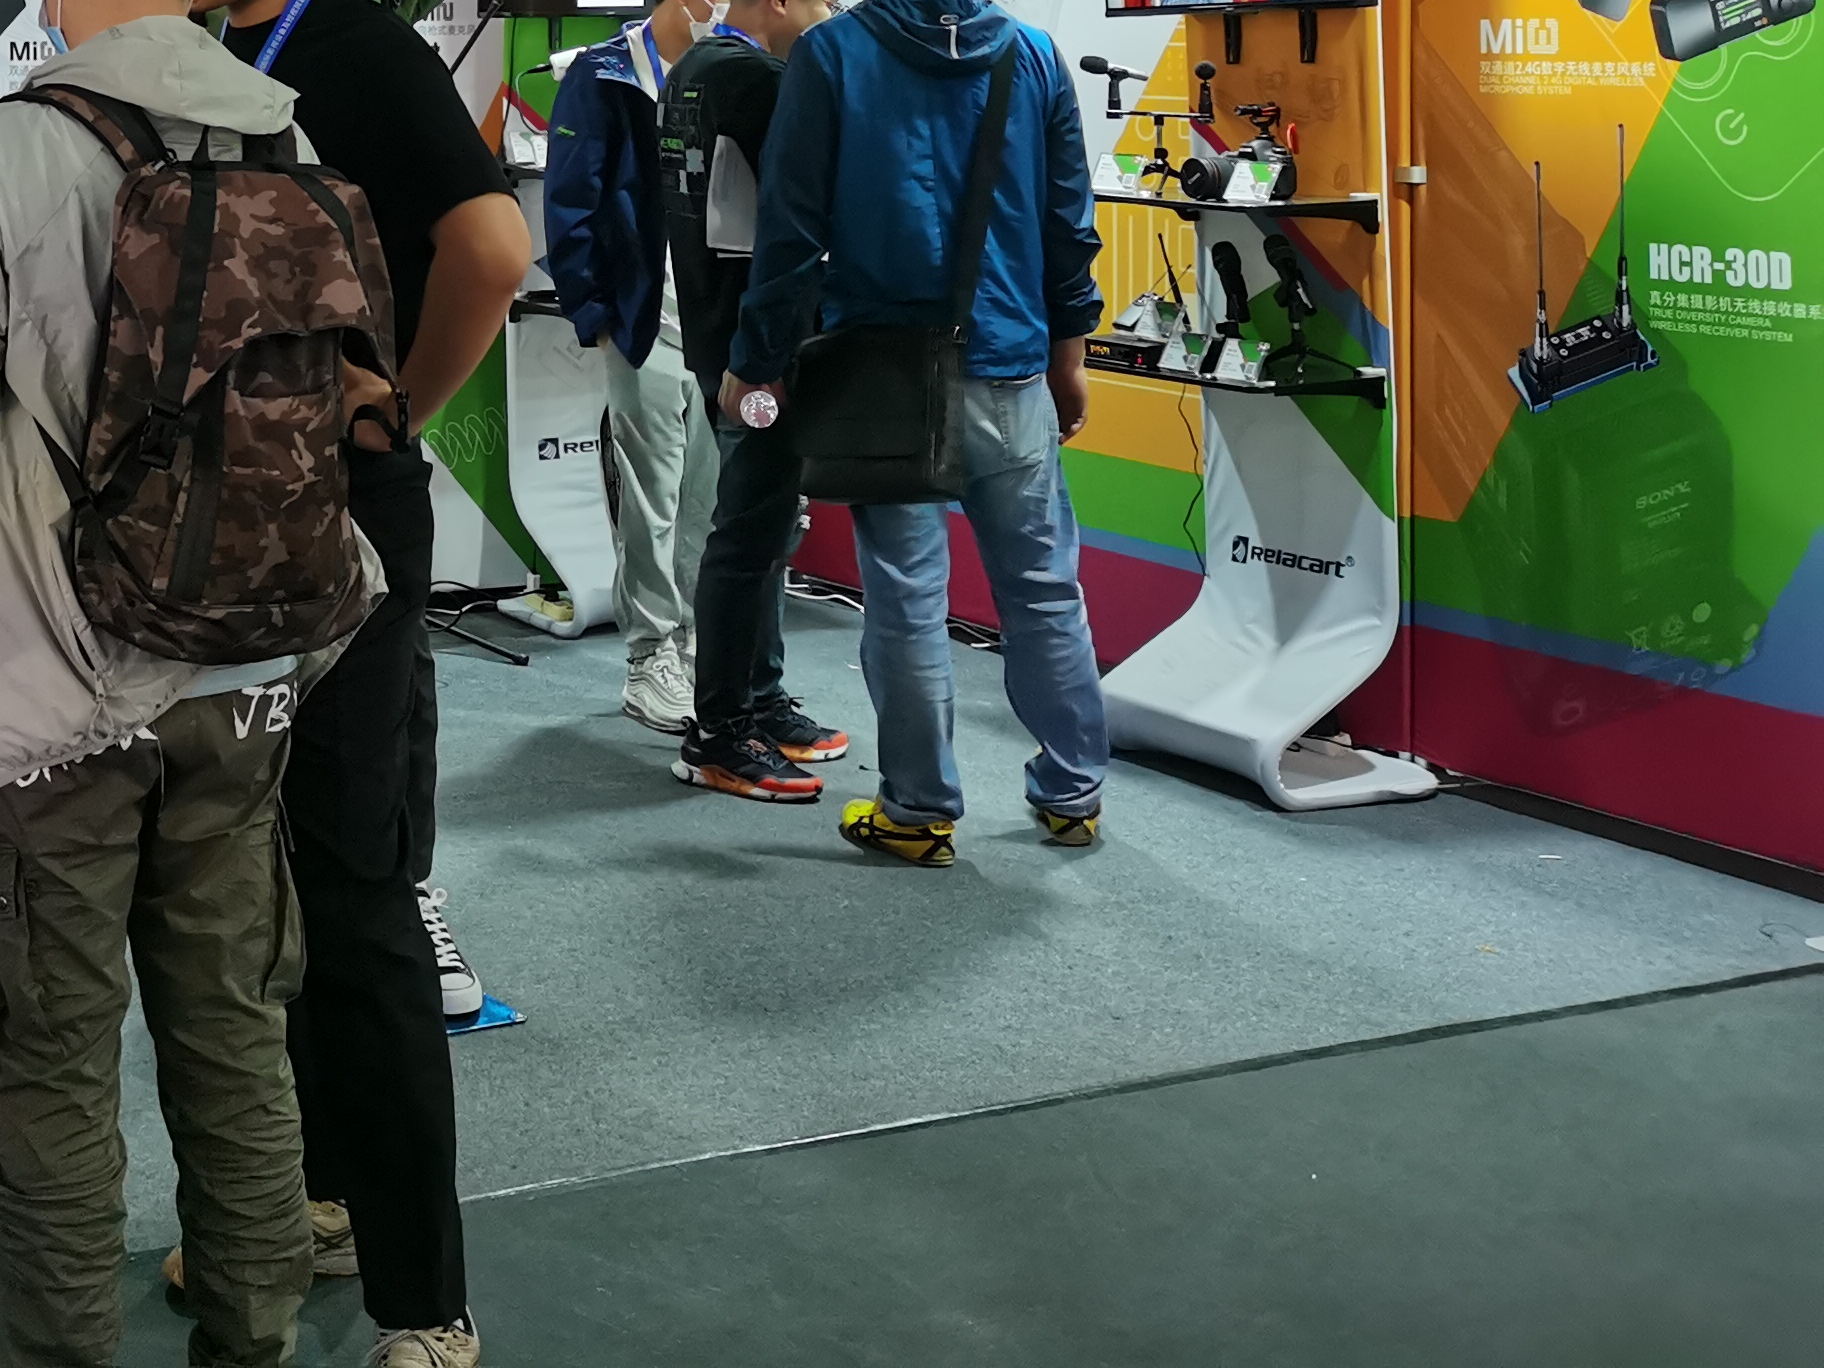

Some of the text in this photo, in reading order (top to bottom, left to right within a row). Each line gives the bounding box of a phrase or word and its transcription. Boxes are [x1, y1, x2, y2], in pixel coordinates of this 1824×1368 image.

[1479, 75, 1502, 85] DUAL
[1503, 76, 1541, 85] CHANNEL
[1563, 76, 1598, 86] DIGITAL
[1599, 76, 1645, 87] WIRELESS
[1479, 85, 1572, 95] MICROPHONE SYSTEM
[1649, 243, 1793, 290] HCR-30D
[1649, 290, 1824, 320] 真分集摄影机无线接收器系
[1649, 307, 1772, 328] TRUE DIVERSITY CAMERA
[1649, 320, 1794, 342] WIRELESS RECEIVER SYSTEM
